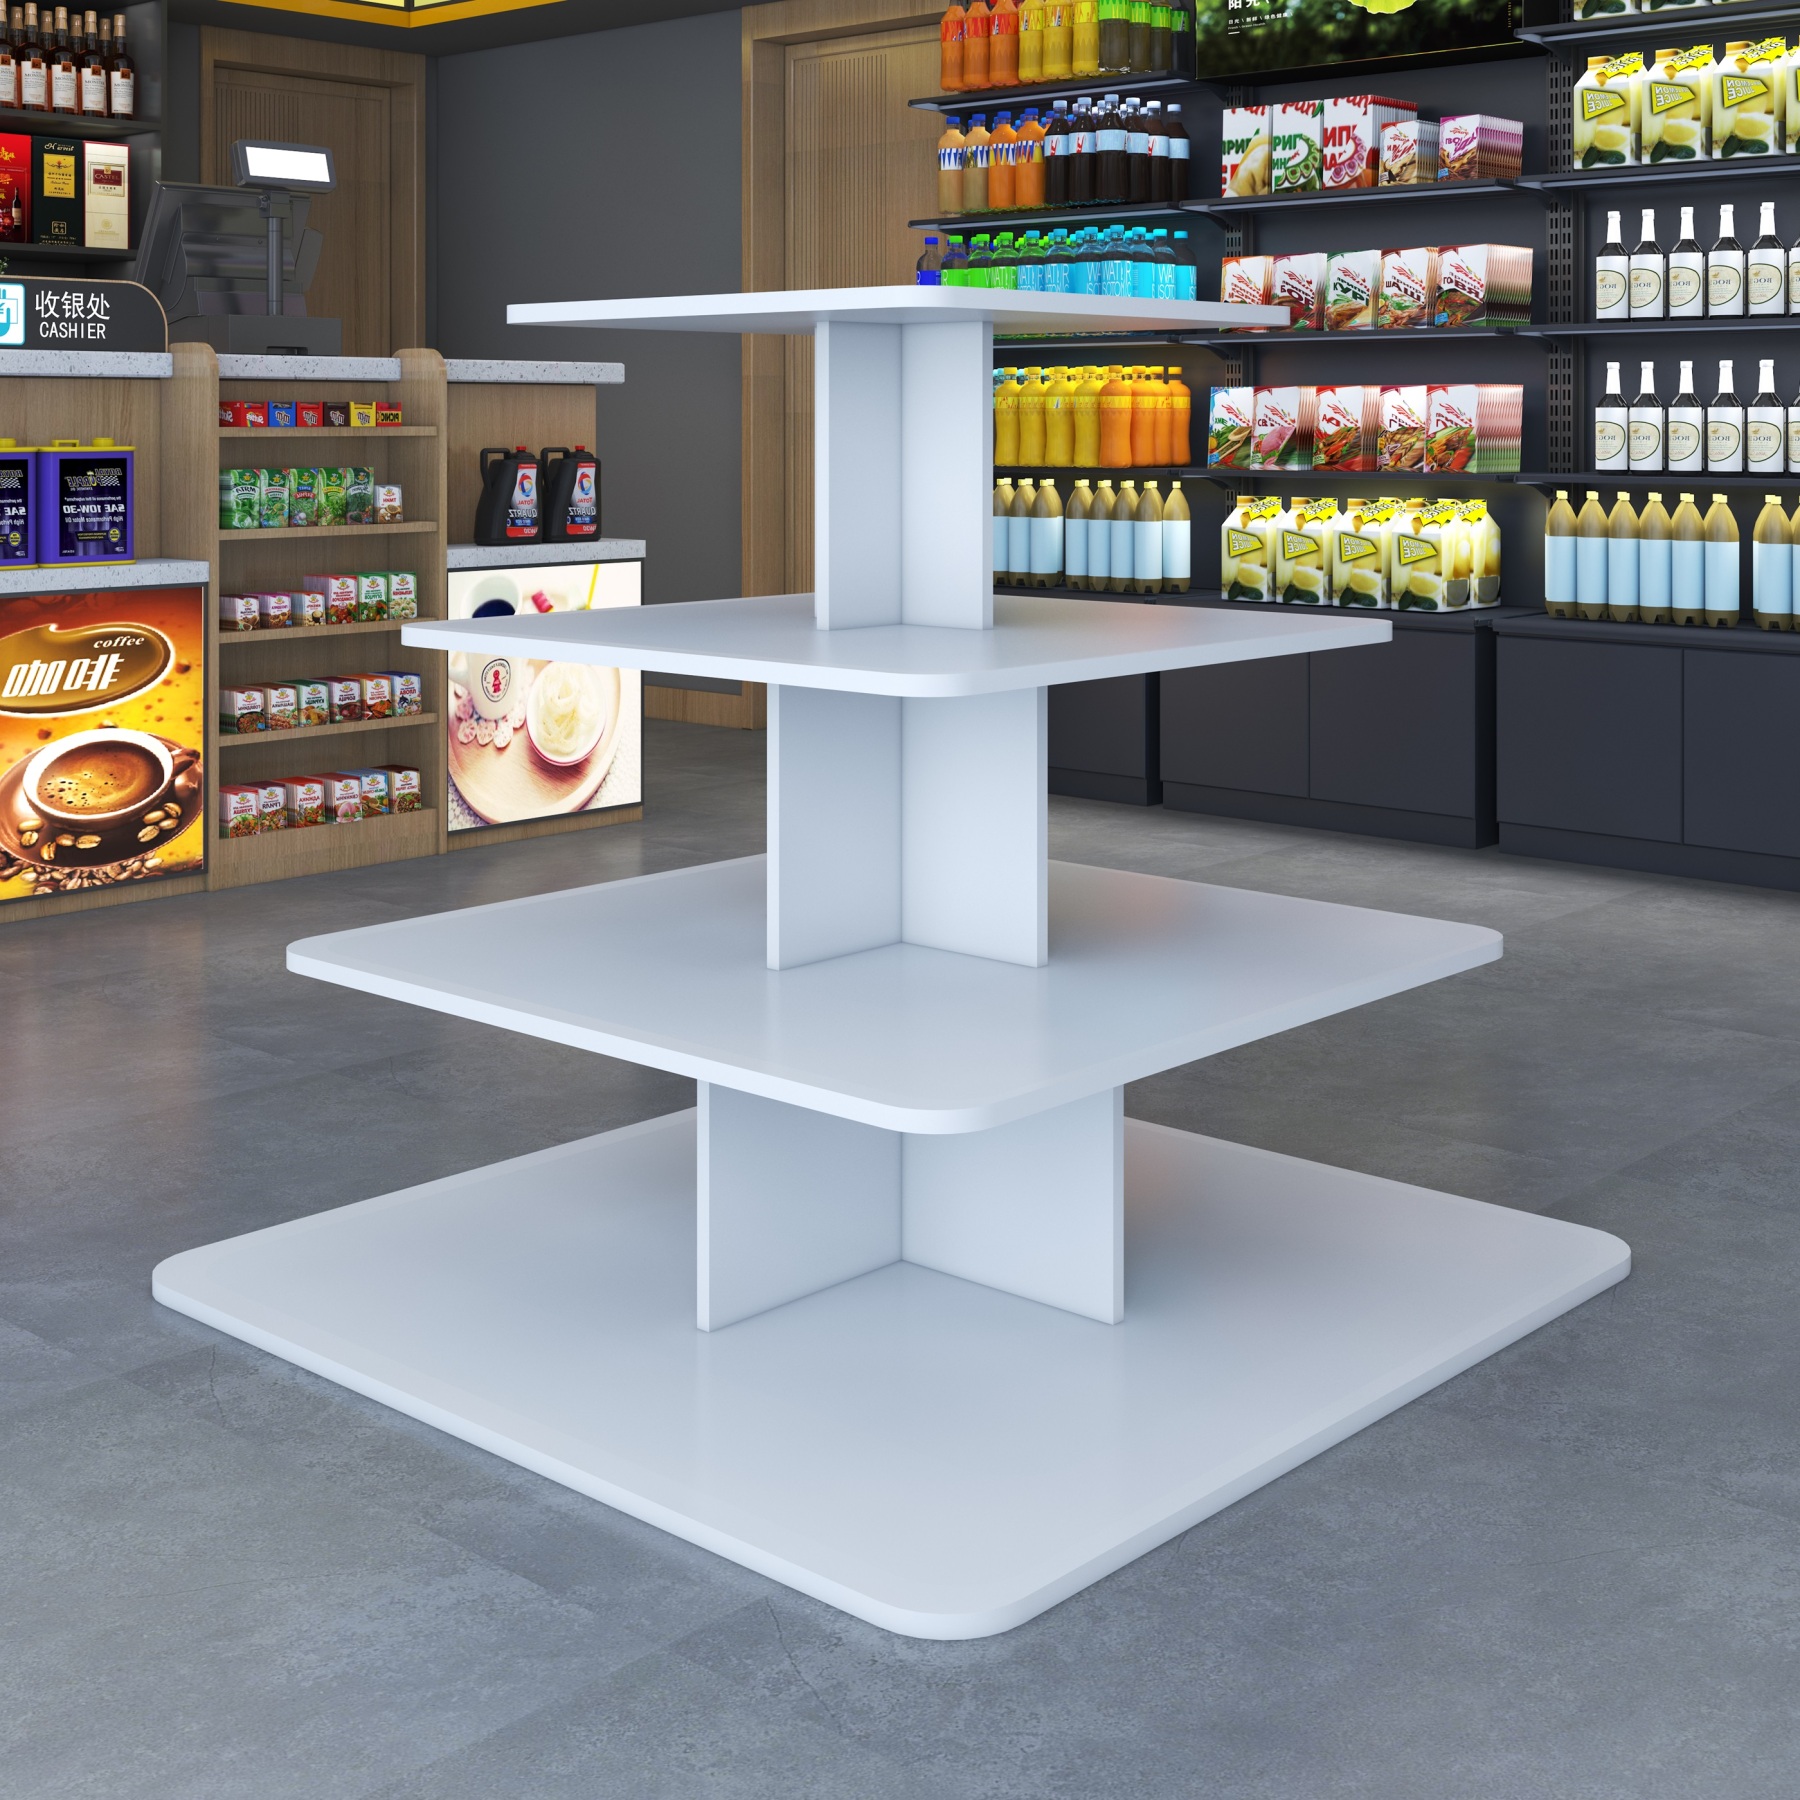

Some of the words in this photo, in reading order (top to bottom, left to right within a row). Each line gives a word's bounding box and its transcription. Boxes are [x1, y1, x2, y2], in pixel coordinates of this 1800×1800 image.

[35, 290, 111, 320] 收银处
[40, 322, 106, 339] CASHIER
[93, 636, 145, 649] coffee
[2, 653, 125, 698] 咖啡
